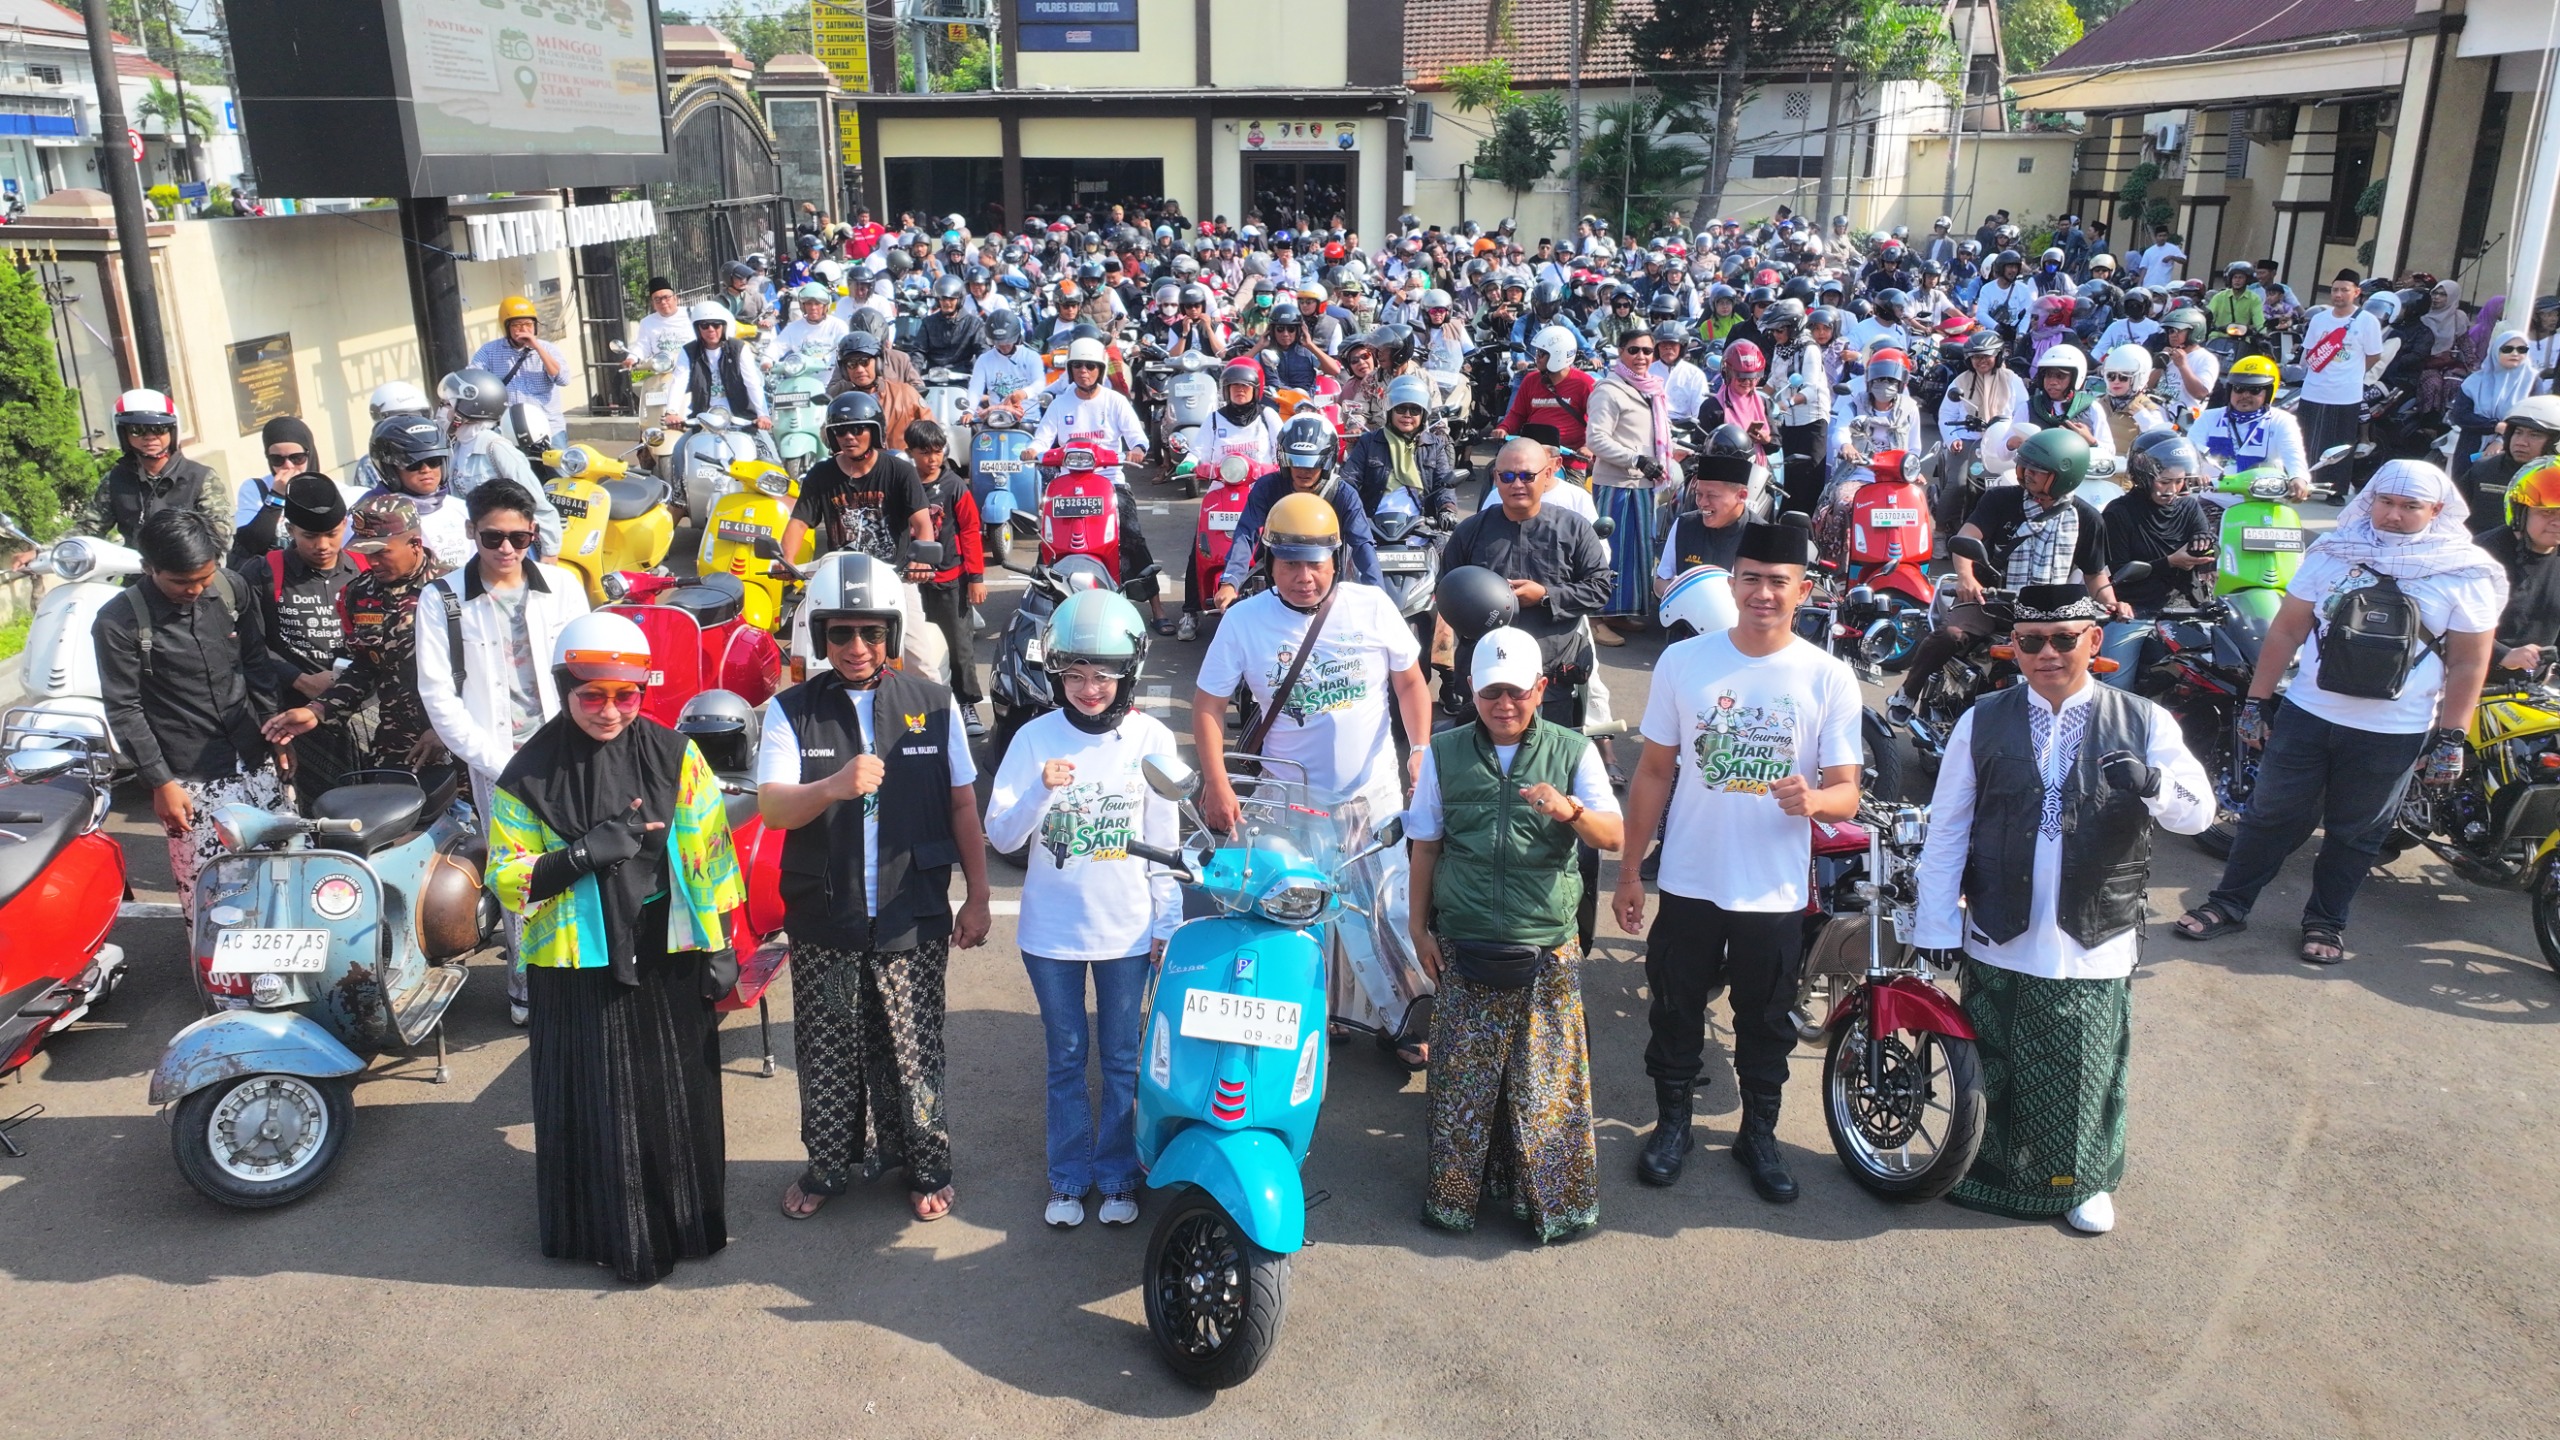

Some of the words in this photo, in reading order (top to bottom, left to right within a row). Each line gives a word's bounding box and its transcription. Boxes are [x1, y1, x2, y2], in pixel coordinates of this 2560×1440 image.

[1036, 2, 1067, 13] POLRES
[1069, 2, 1096, 13] KEDIRI
[1097, 2, 1119, 13] KOTA
[428, 18, 483, 36] PASTIKAN
[826, 21, 863, 29] SATBINMAS
[536, 35, 603, 57] MINGGU
[826, 35, 865, 43] SATSAMAPTA
[548, 50, 585, 62] OKTOBER
[827, 48, 857, 56] SATTAHTI
[828, 61, 850, 69] SIWAS
[539, 71, 570, 83] TITIK
[573, 75, 613, 89] KUMPUL
[541, 84, 583, 98] START
[466, 208, 567, 262] TATHYA
[565, 200, 658, 248] DHARAKA
[1069, 430, 1105, 440] TOURING
[1221, 441, 1259, 456] TOURING
[1054, 498, 1102, 509] AG3263ECV
[1220, 512, 1239, 521] 5880
[719, 520, 731, 530] AG
[734, 523, 756, 533] 4163
[293, 594, 321, 604] Don't
[1496, 647, 1507, 660] LA
[1316, 660, 1362, 679] Touring
[1320, 677, 1349, 692] HARI
[1304, 683, 1367, 714] SANTRI
[1747, 726, 1793, 747] Touring
[808, 749, 834, 757] QOWIM
[1732, 743, 1773, 758] HARI
[1705, 751, 1794, 783] SANTRI
[1723, 779, 1768, 795] 2026
[1094, 816, 1130, 829] HARI
[1092, 849, 1129, 863] 2026
[1894, 911, 1903, 926] S
[222, 934, 243, 949] AG
[252, 934, 294, 950] 3267
[303, 934, 325, 949] AS
[208, 971, 244, 987] 001
[1186, 994, 1209, 1013] AG
[1220, 998, 1265, 1020] 5155
[1277, 1005, 1298, 1025] CA
